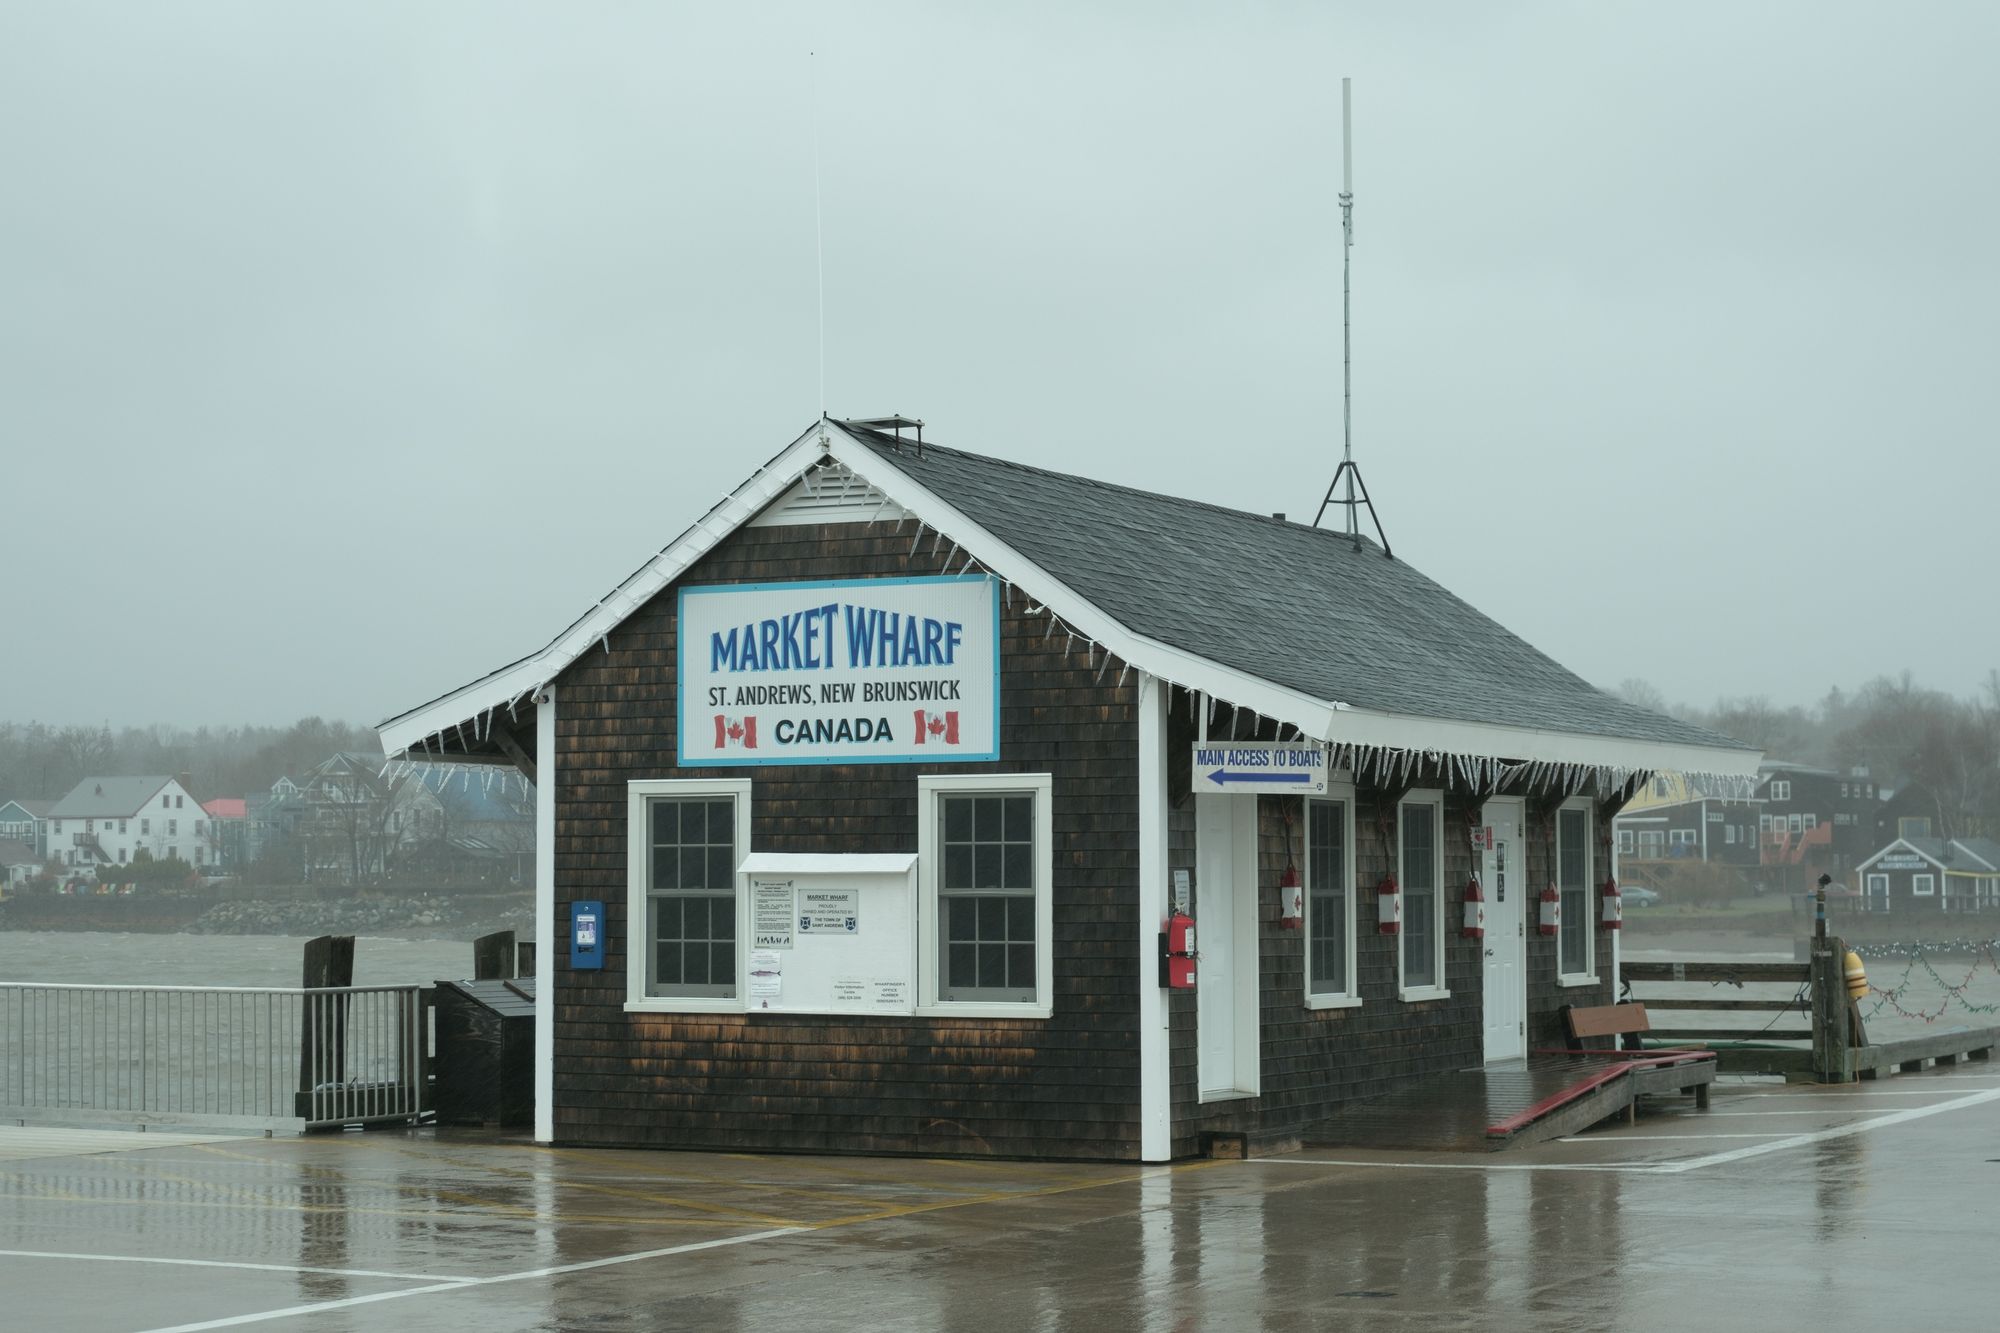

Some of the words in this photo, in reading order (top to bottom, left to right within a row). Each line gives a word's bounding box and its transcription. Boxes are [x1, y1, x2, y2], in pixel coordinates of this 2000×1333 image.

[710, 602, 838, 673] MARKET
[844, 604, 962, 668] WHARF
[709, 686, 731, 706] ST.
[736, 684, 817, 706] ANDREWS,
[821, 683, 856, 703] NEW
[864, 680, 961, 702] BRUNSWICK
[775, 717, 894, 744] CANADA
[1197, 750, 1225, 766] MAIN
[1227, 750, 1270, 766] ACCESS
[1273, 750, 1286, 767] TO
[1289, 750, 1323, 767] BOATS
